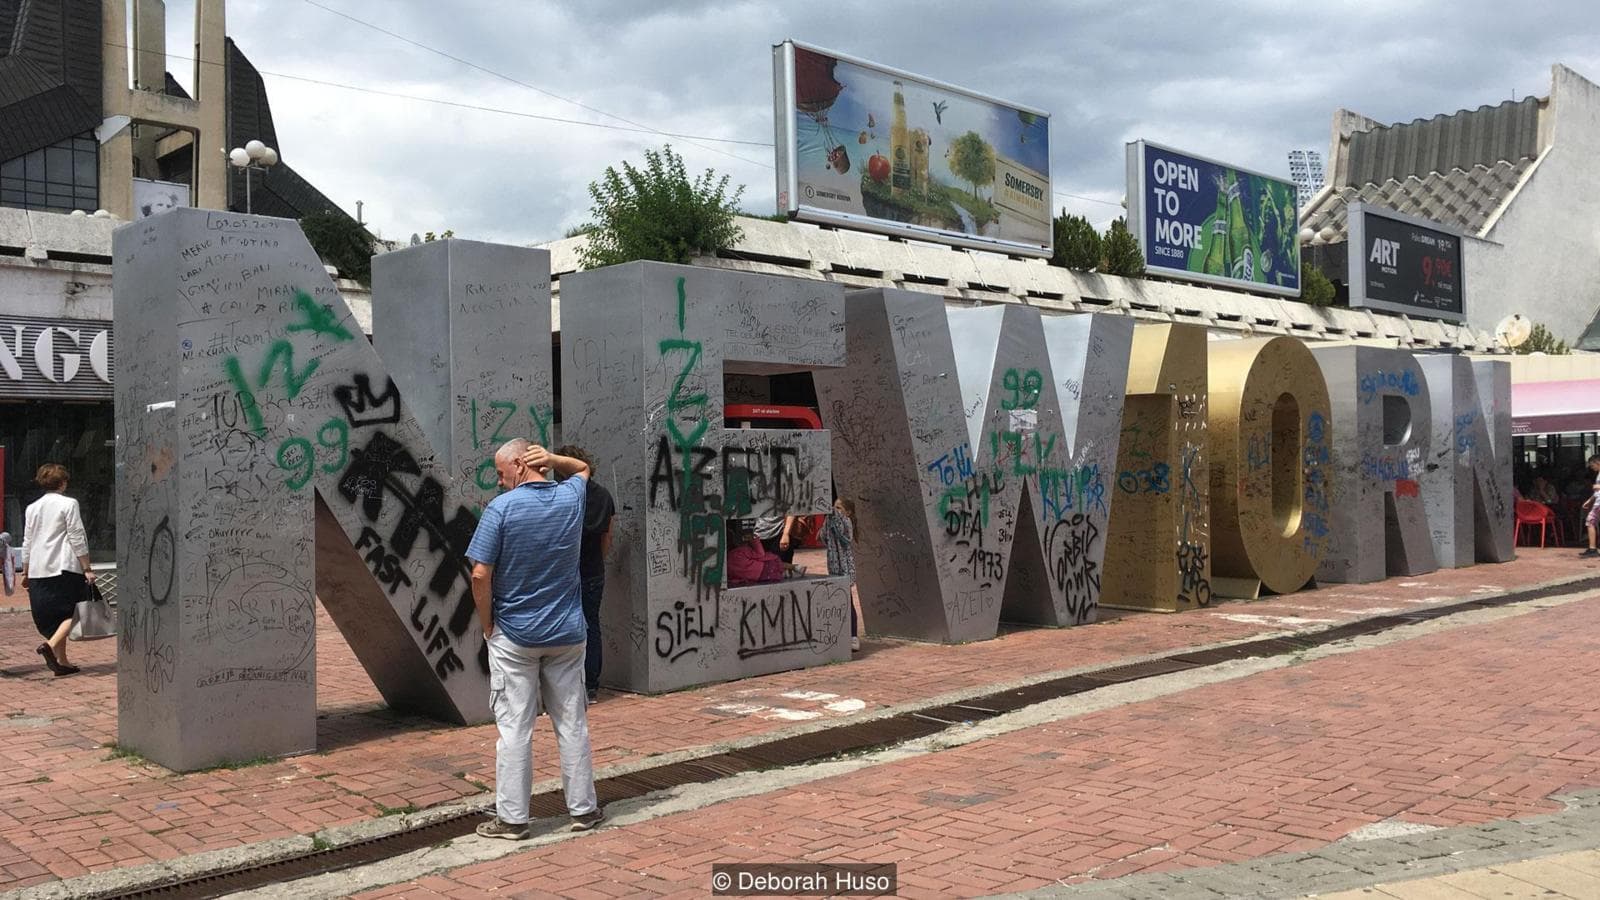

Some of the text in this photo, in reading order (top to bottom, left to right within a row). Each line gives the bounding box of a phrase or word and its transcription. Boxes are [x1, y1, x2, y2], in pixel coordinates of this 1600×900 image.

[1005, 172, 1044, 201] SOMERSBY
[1153, 158, 1199, 193] OPEN
[1154, 187, 1180, 216] TO
[1155, 217, 1203, 250] MORE
[1154, 245, 1184, 259] SINCE 1880
[1369, 237, 1401, 268] ART
[1001, 367, 1044, 411] 99
[355, 526, 411, 595] FAST
[967, 548, 1004, 580] 1973
[739, 589, 813, 648] KMN
[410, 597, 465, 681] LIFE
